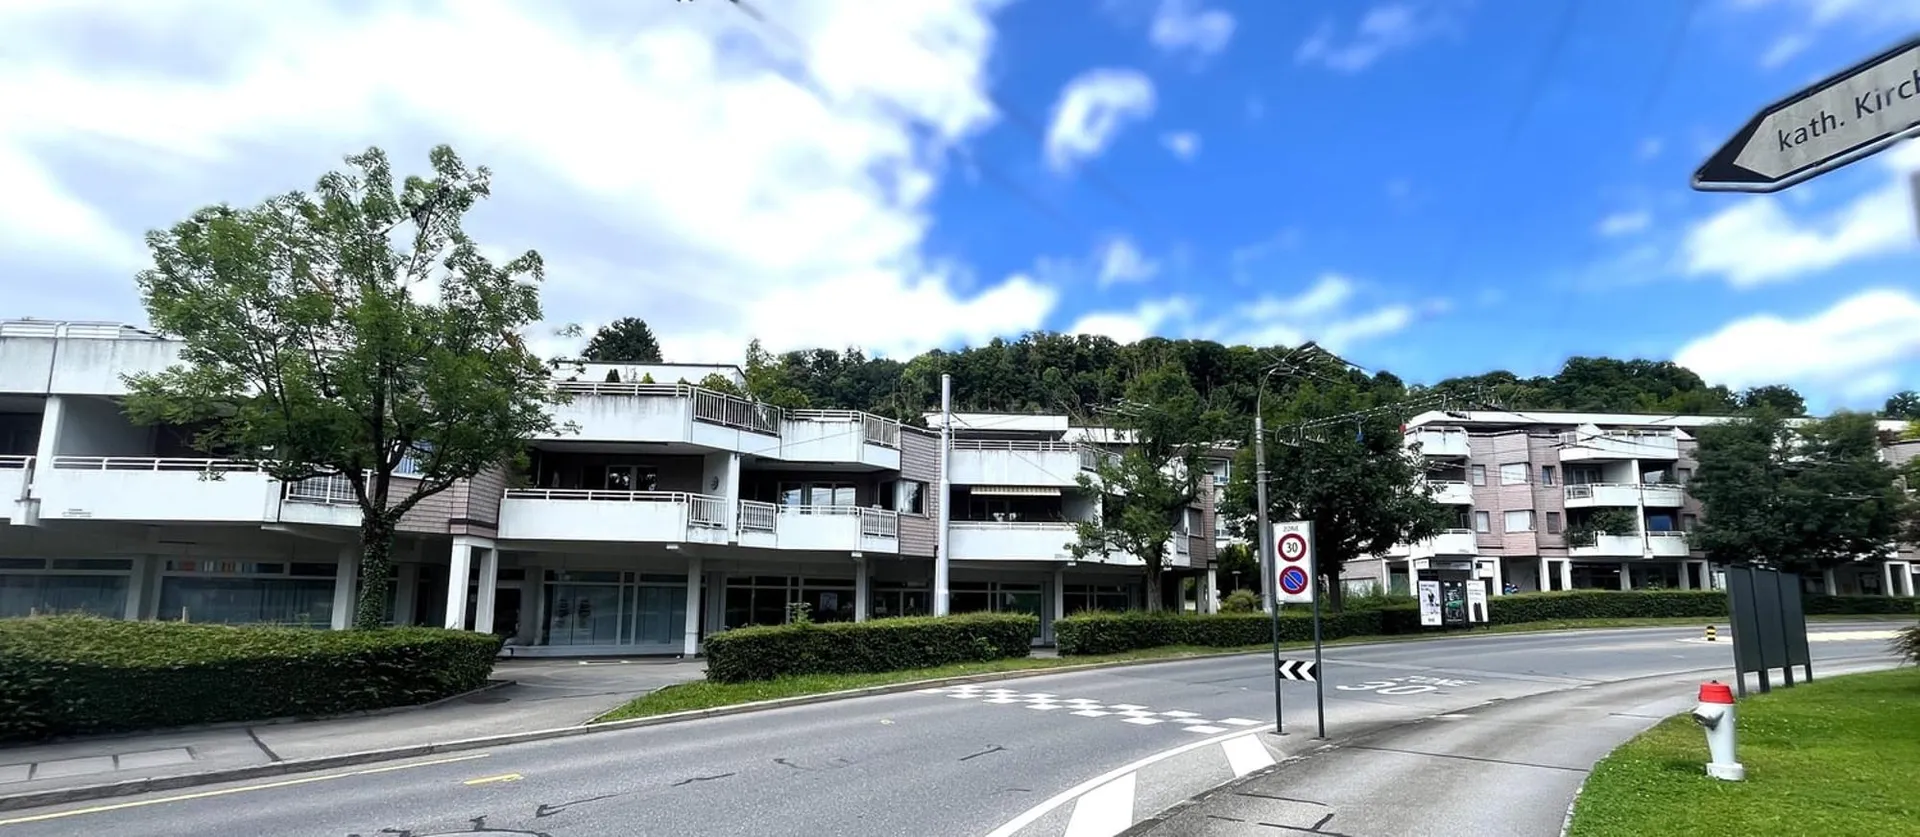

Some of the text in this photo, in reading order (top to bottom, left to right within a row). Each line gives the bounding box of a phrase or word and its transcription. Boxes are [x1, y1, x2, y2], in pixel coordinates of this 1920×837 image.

[1777, 110, 1846, 152] kath.
[1285, 541, 1299, 554] 30
[1335, 681, 1438, 695] 30
